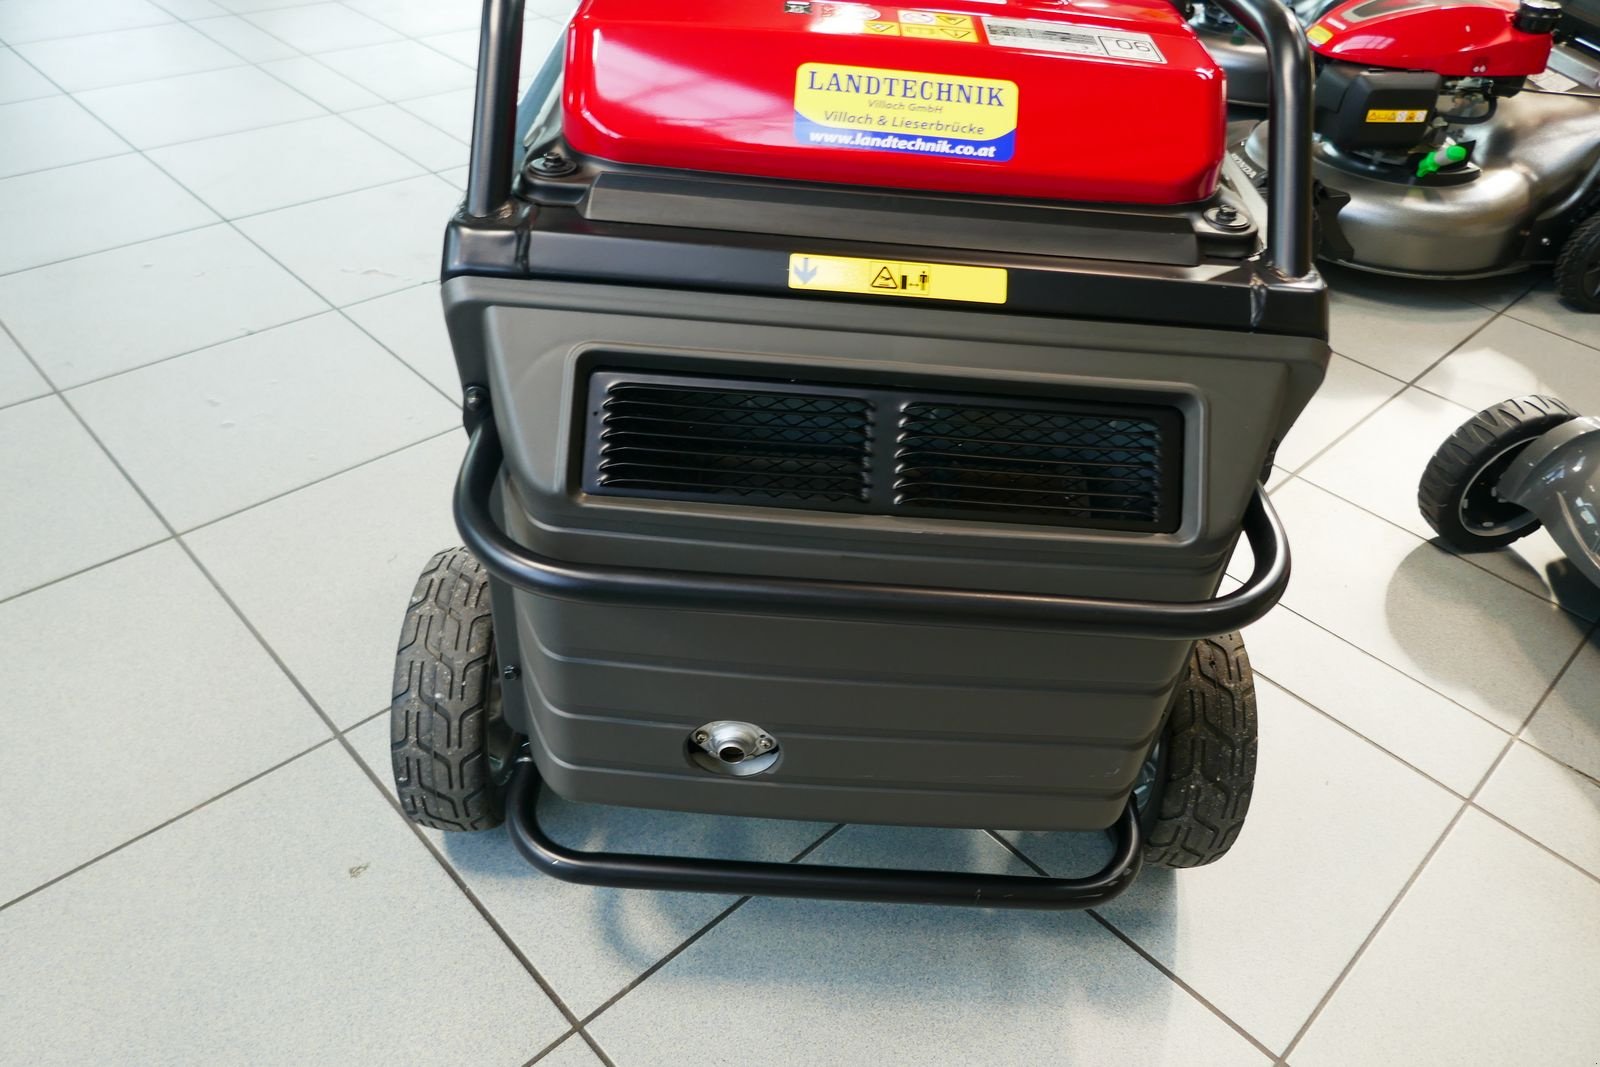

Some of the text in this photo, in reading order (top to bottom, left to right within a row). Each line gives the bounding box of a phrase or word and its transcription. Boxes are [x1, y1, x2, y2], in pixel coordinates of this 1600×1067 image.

[807, 70, 1005, 107] LANDTECHNIK
[867, 99, 944, 114] Villach GmbH
[823, 110, 985, 135] Villach & Lieserbrücke
[808, 131, 997, 158] www.landtechnik.co.at
